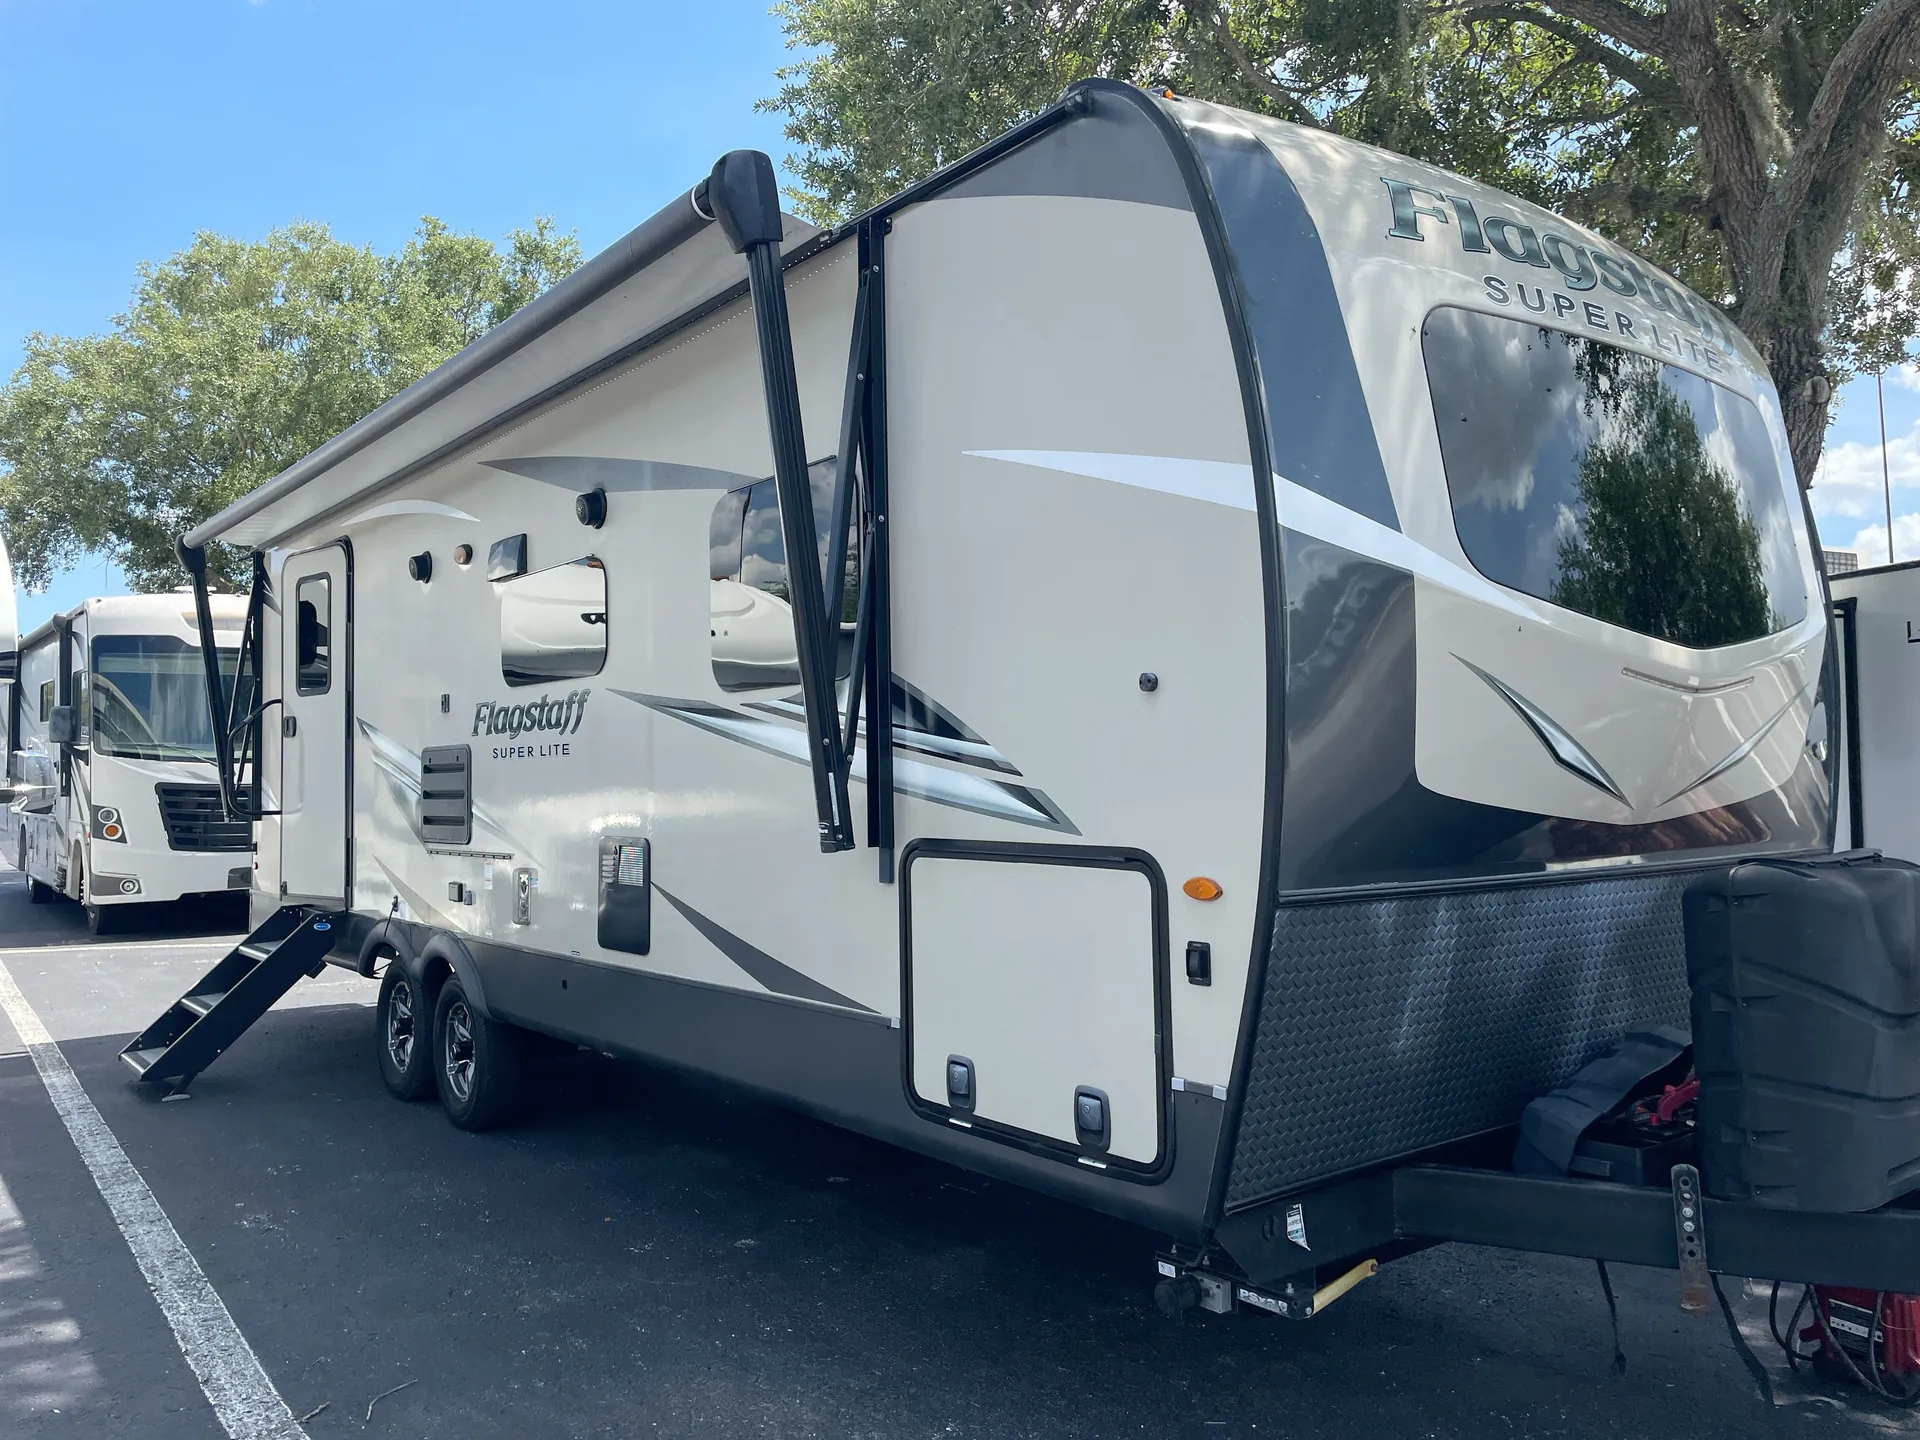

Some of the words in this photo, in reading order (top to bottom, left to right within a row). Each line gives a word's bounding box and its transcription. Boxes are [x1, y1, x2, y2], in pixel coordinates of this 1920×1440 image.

[1483, 275, 1640, 341] SUPER
[1651, 326, 1725, 375] LITE
[471, 688, 591, 740] Flagstaff
[493, 746, 534, 759] SUPER
[540, 743, 570, 757] LITE
